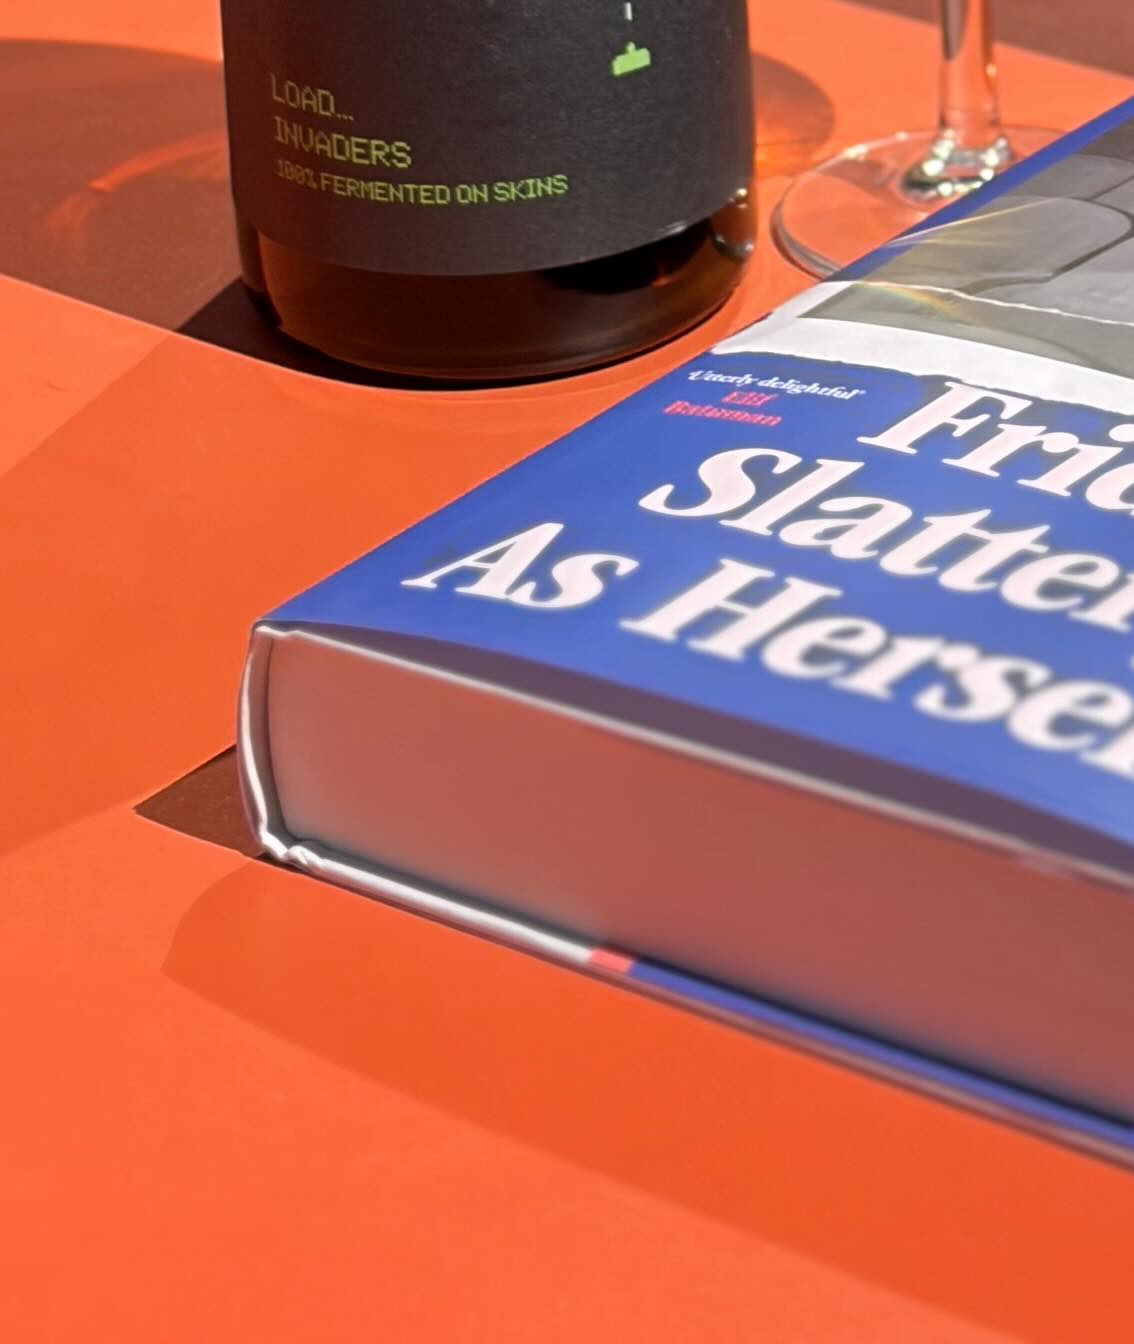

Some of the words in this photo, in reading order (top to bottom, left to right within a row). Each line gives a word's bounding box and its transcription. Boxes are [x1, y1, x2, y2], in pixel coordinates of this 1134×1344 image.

[271, 73, 354, 121] LOAD...
[273, 116, 412, 169] INVADERS
[277, 159, 318, 190] 100%
[320, 176, 450, 204] FERMENTED
[456, 183, 488, 204] ON
[493, 174, 569, 202] SKINS
[401, 520, 638, 611] As
